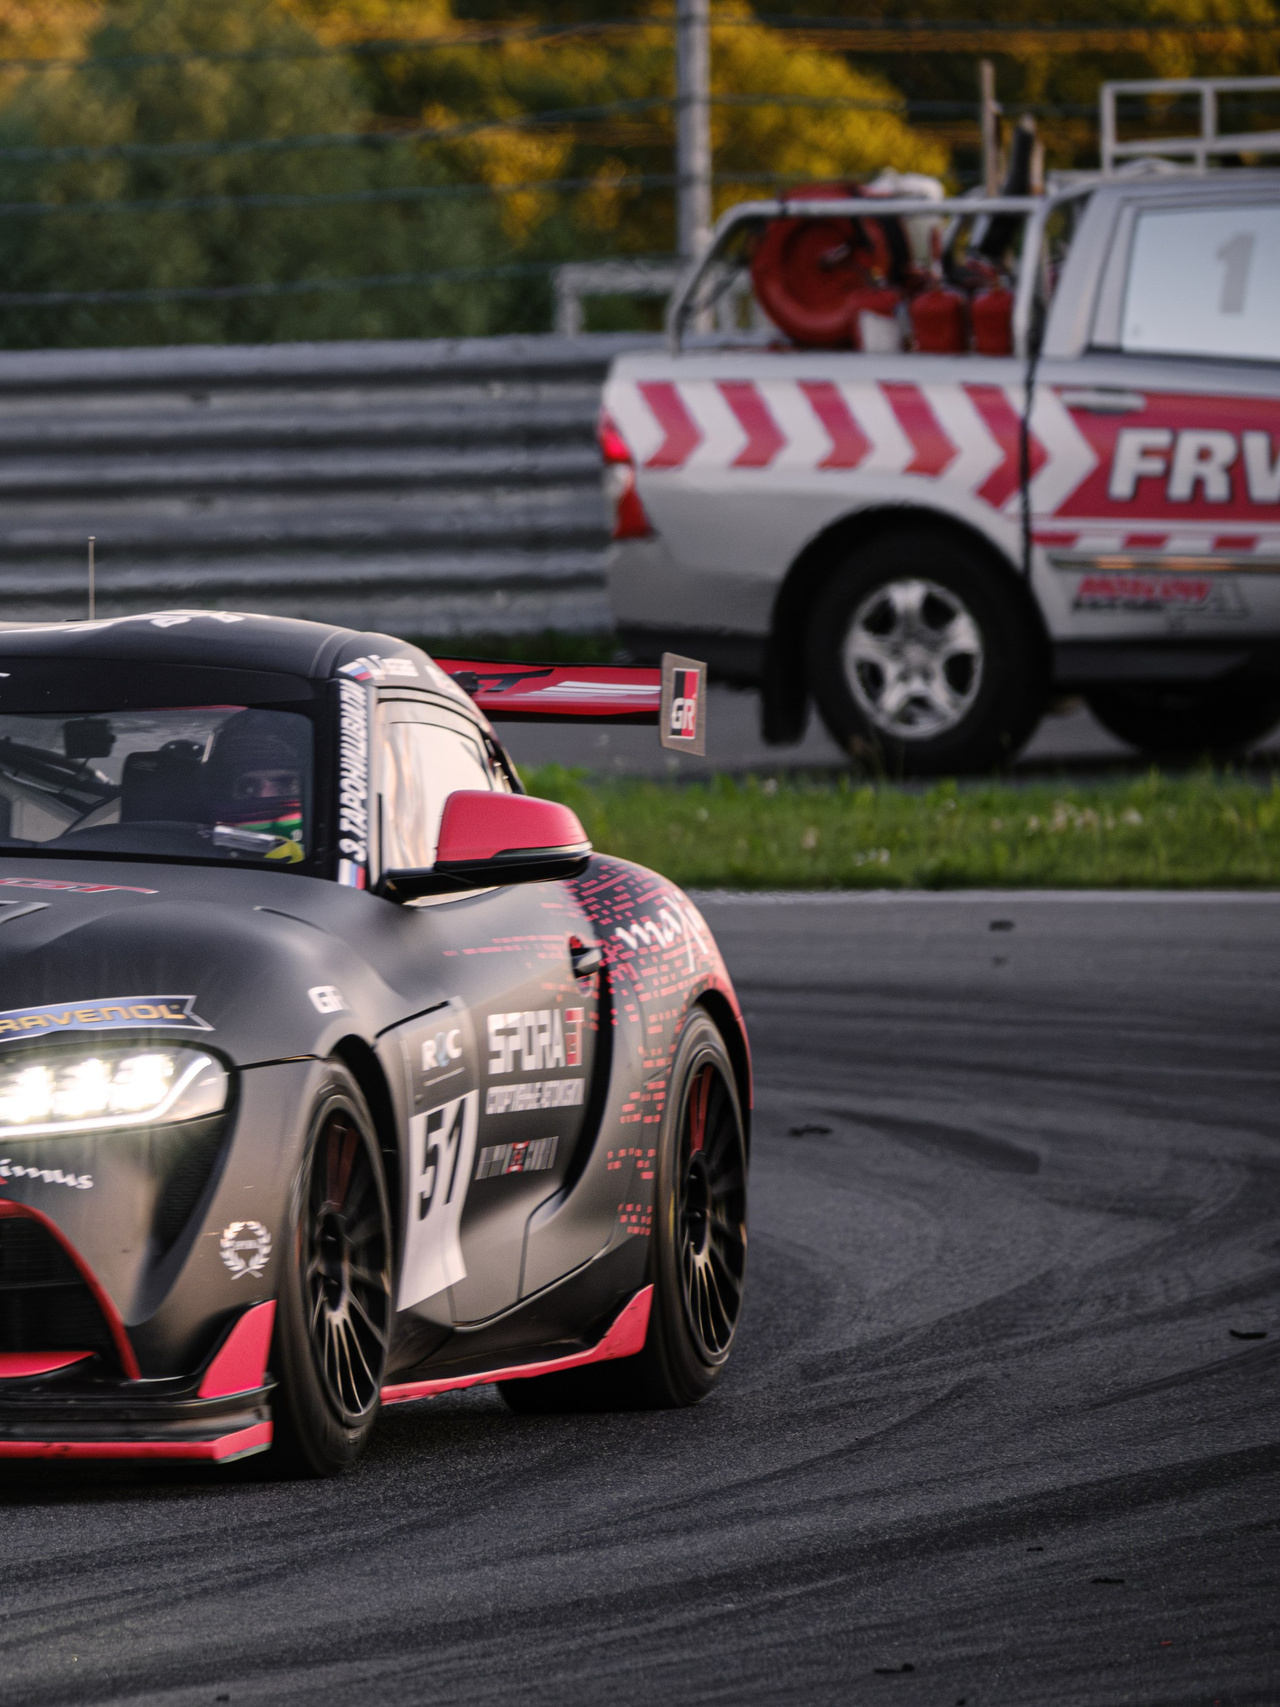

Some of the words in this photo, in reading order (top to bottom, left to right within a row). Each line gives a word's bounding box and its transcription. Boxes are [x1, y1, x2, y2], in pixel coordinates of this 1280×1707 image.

[1216, 232, 1255, 315] 1
[671, 697, 696, 731] GR
[487, 1009, 566, 1075] SPORA
[418, 1098, 466, 1222] 51
